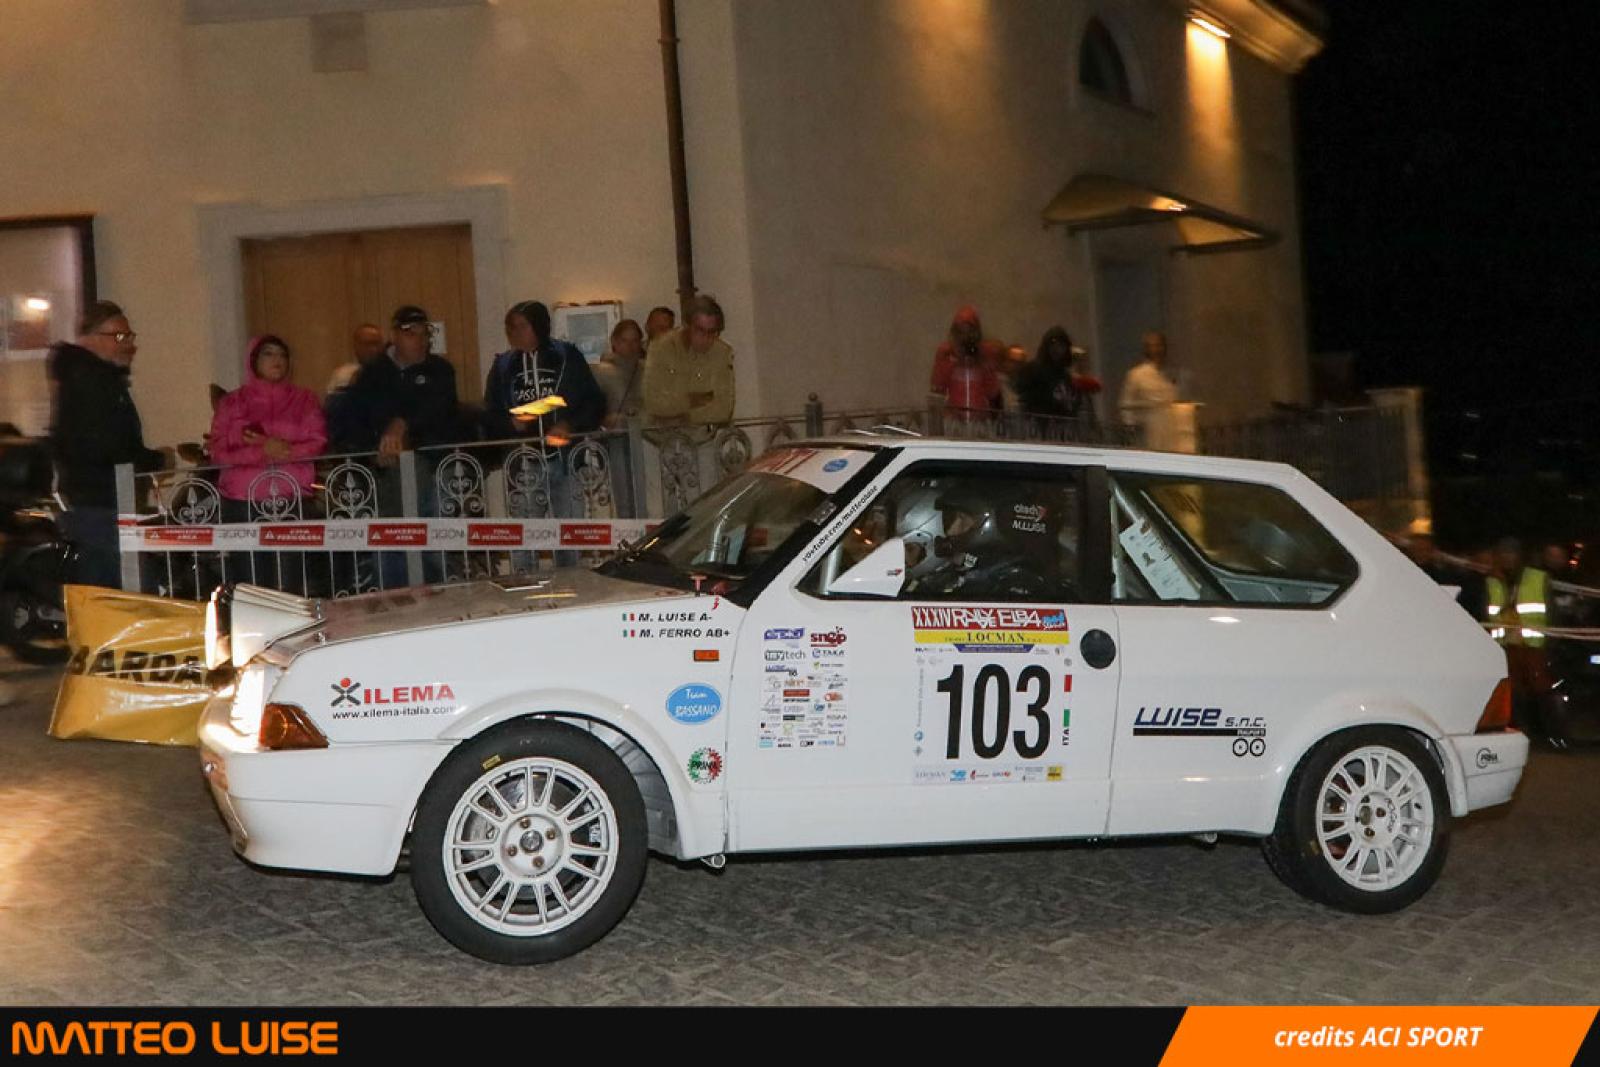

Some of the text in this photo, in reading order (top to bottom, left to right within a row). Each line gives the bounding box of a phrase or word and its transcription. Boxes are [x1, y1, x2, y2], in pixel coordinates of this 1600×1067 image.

[638, 612, 713, 622] M. LUISE A-
[639, 628, 731, 638] M. FERRO AB+
[966, 631, 1025, 643] LOCMAN
[331, 679, 455, 707] XILEMA
[937, 663, 1051, 760] 103
[1134, 707, 1268, 727] LUISE s.n.c.
[1062, 728, 1070, 746] ITA
